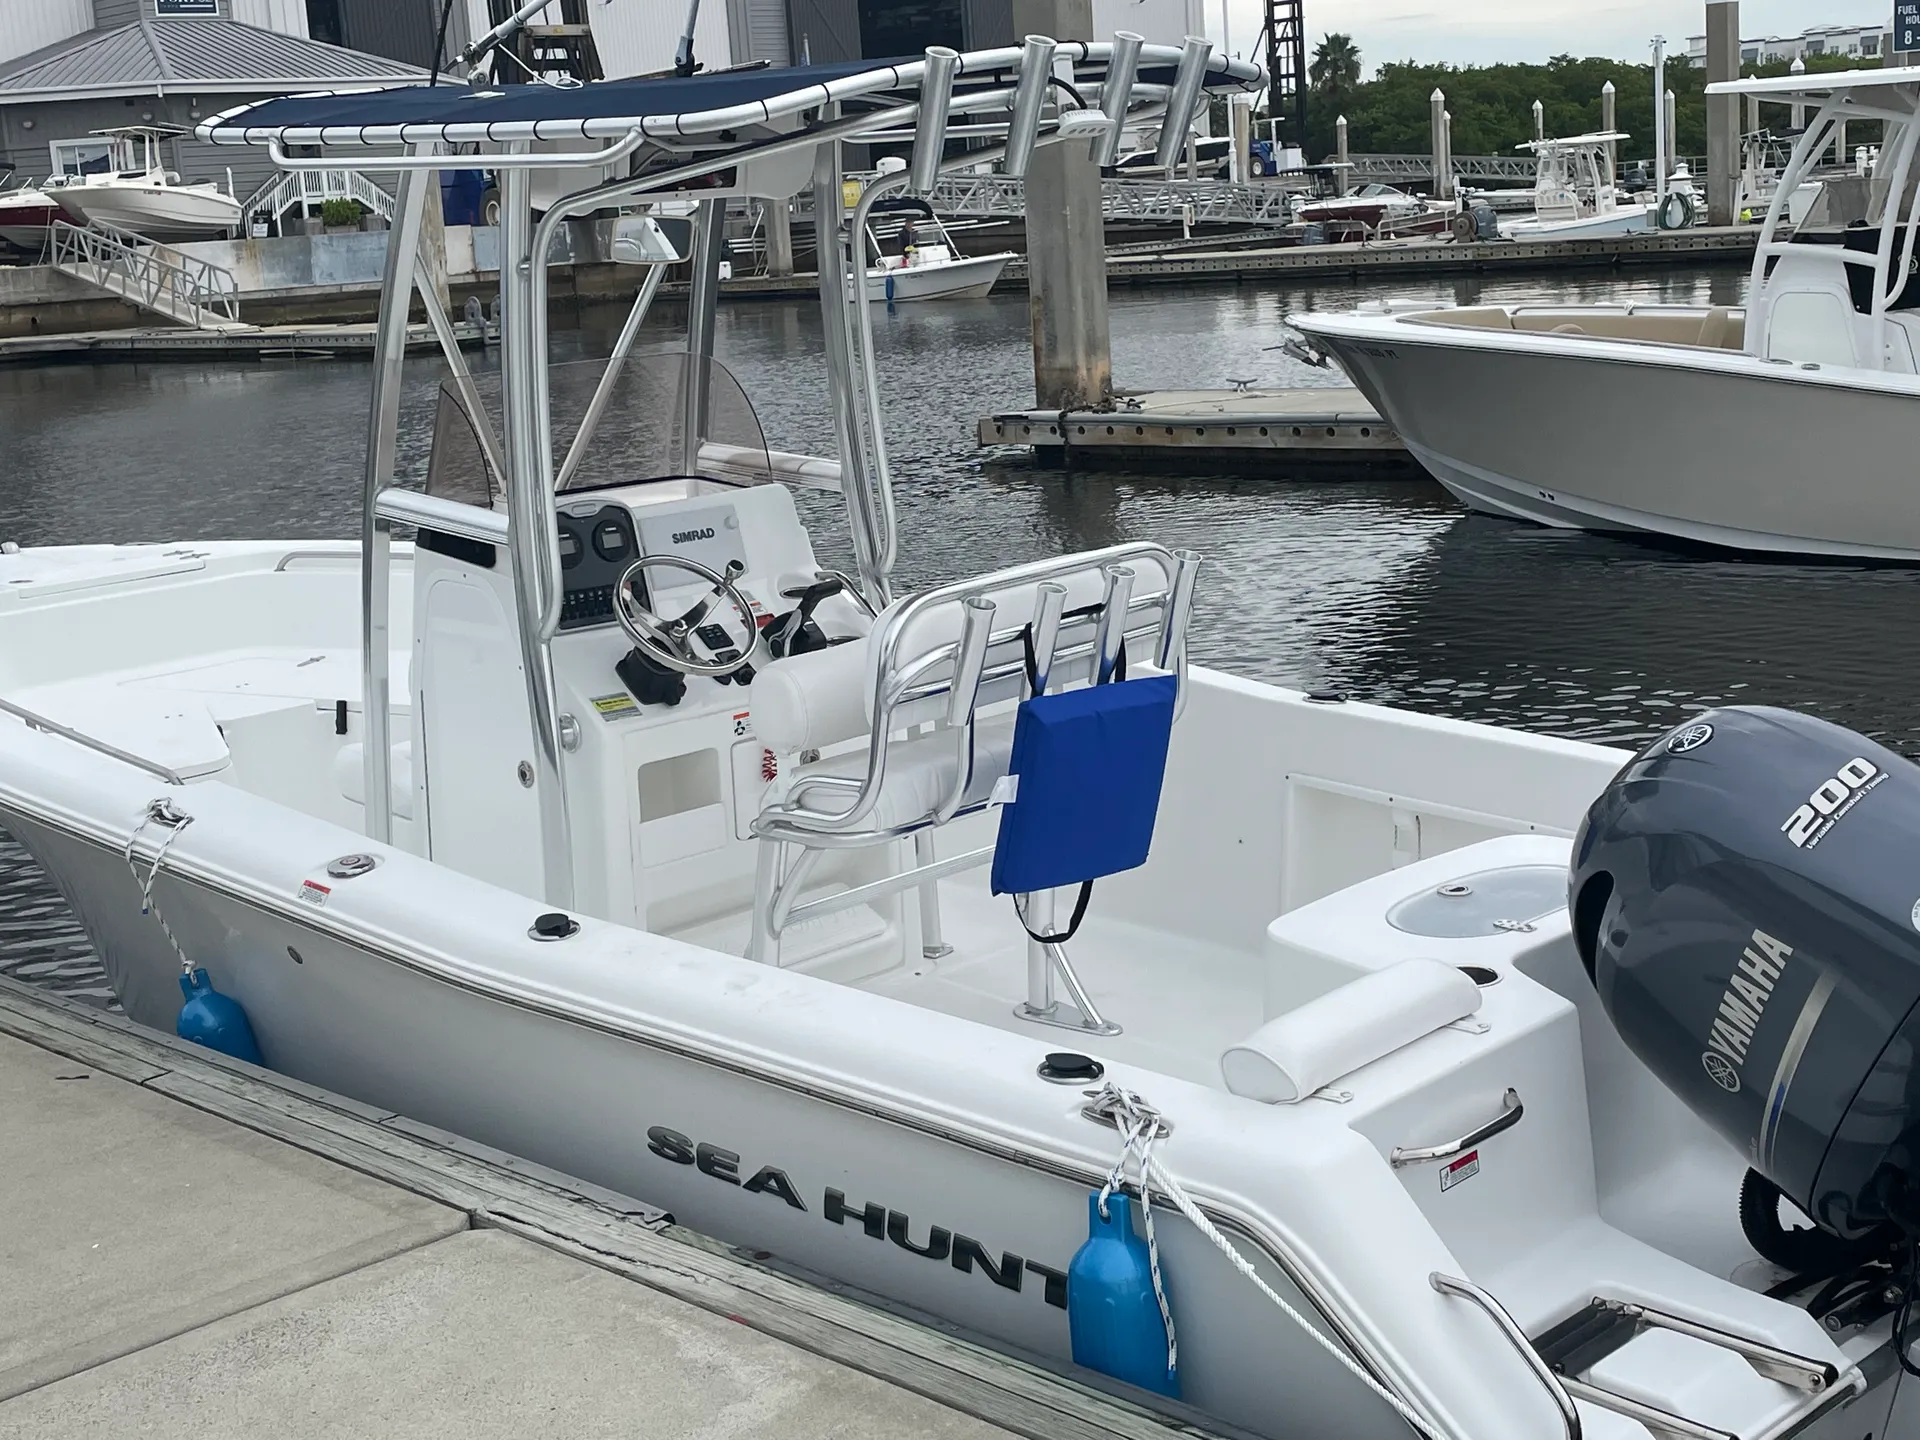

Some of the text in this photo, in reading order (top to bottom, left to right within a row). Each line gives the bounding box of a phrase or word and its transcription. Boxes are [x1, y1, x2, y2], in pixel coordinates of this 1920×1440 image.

[1897, 4, 1918, 15] FUEL
[1904, 30, 1912, 45] 8
[671, 527, 715, 544] SIMRAD
[1780, 757, 1877, 848] 200
[1805, 771, 1890, 850] Variable Camshaft Timing
[1708, 928, 1794, 1066] YAMAHA
[647, 1125, 1068, 1310] SEA HUNT
